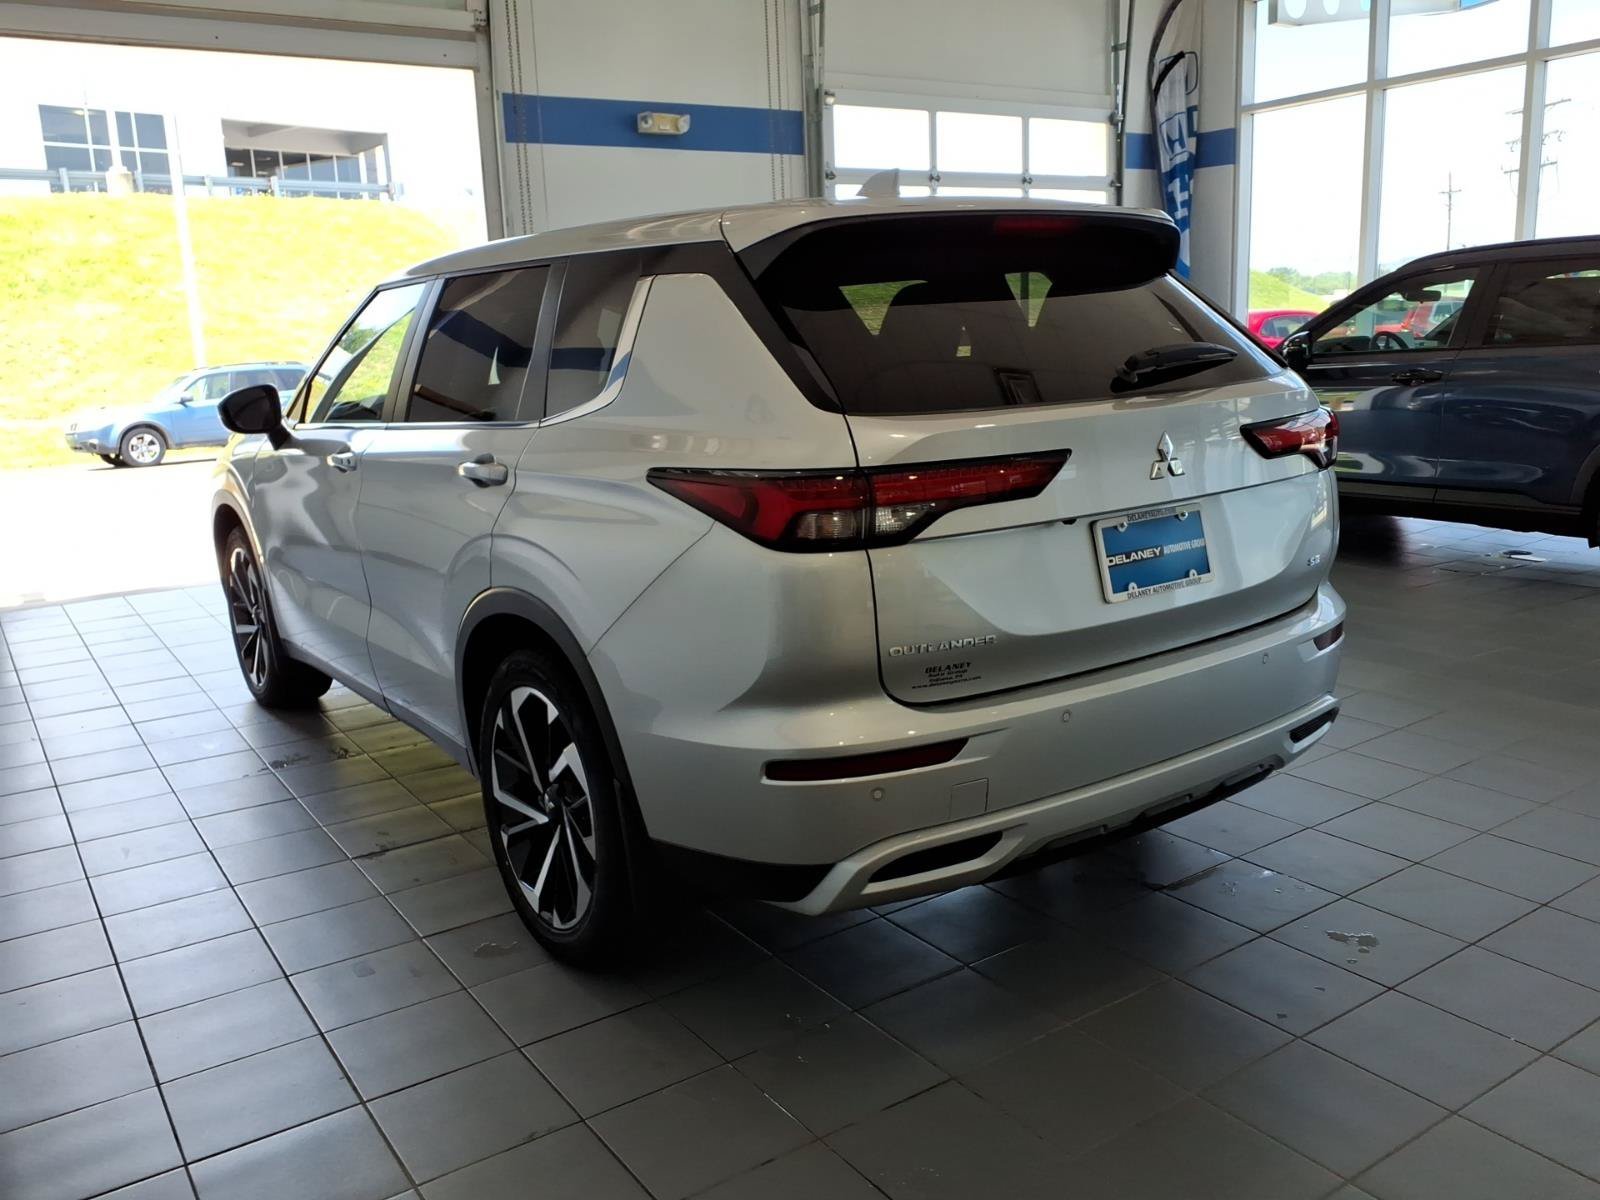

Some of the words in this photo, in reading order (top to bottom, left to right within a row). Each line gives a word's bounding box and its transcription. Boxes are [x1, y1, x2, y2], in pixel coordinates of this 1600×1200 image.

[1107, 547, 1162, 566] DELANEY
[1127, 588, 1152, 600] DELANEY
[1153, 582, 1185, 594] AUTOMOTIVE
[889, 634, 997, 657] OUTLANDER
[925, 662, 972, 674] DELANEY
